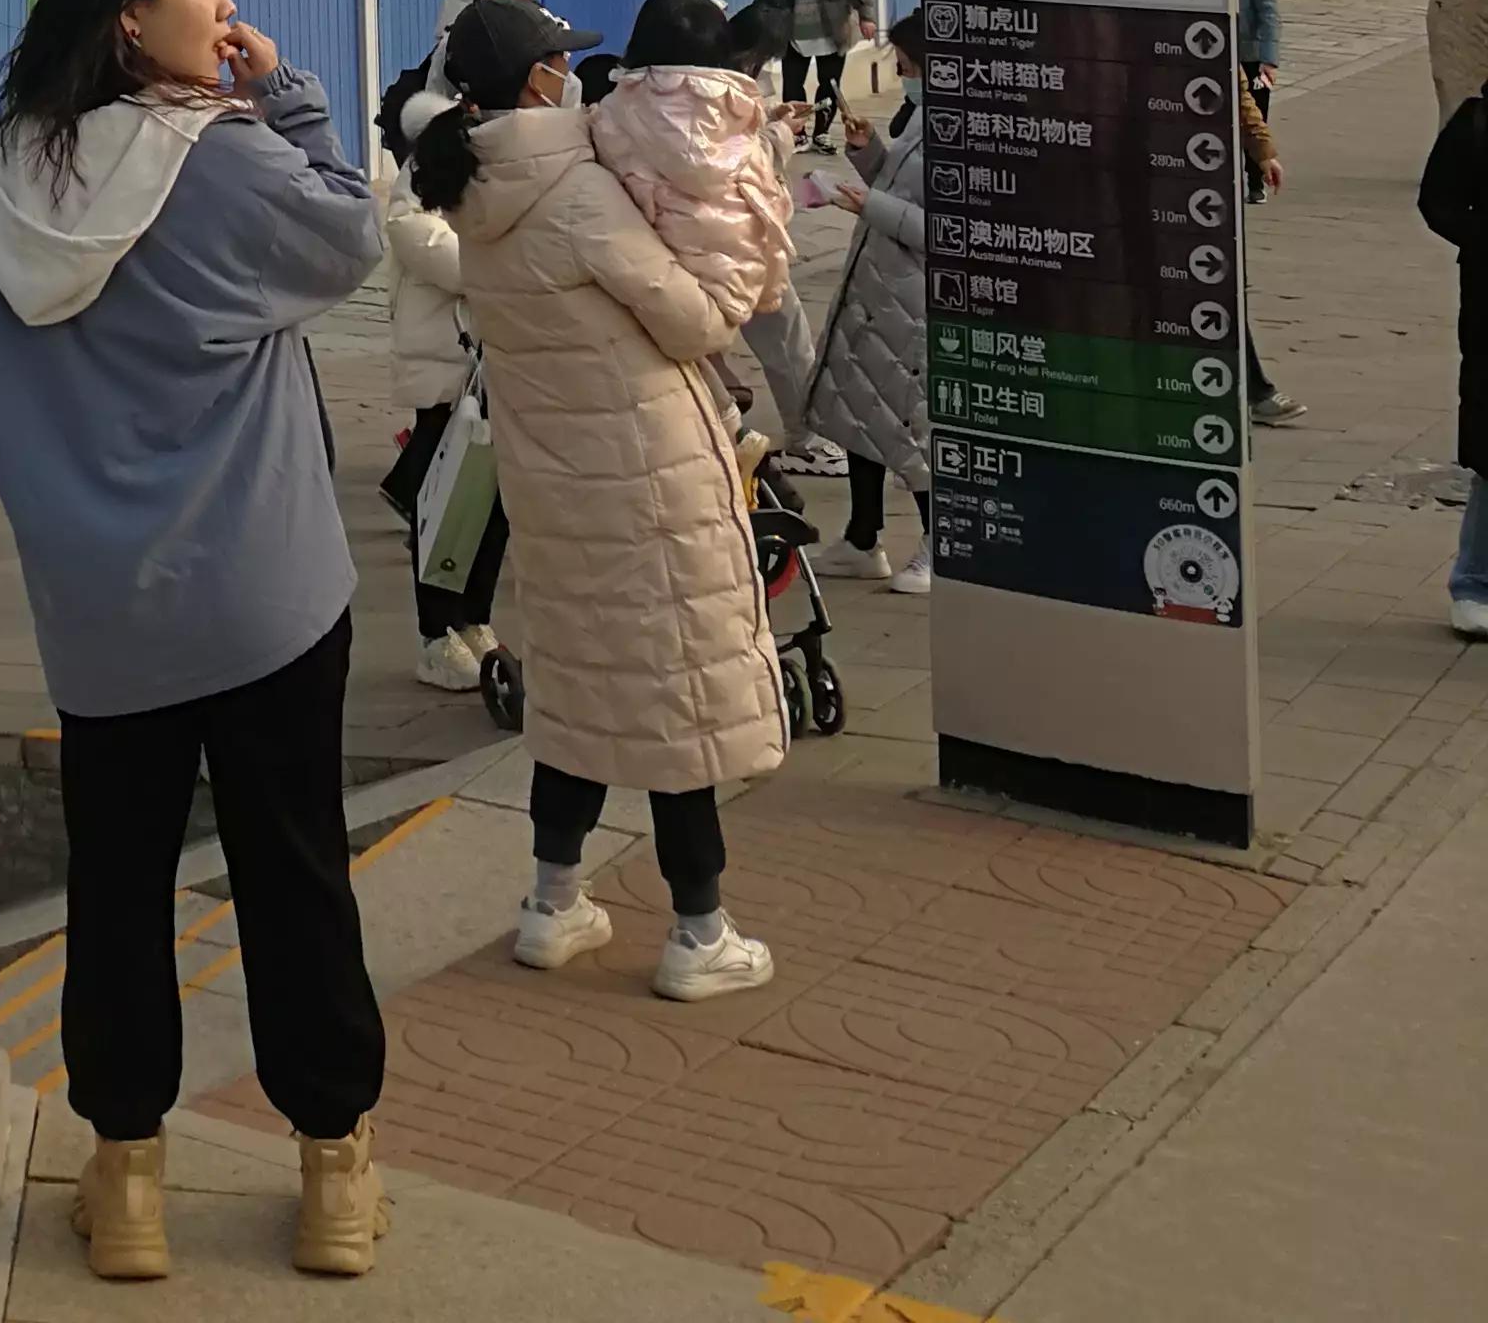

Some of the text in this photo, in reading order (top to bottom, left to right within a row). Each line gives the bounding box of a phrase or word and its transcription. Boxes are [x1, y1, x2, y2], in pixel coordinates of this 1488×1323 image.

[965, 4, 1038, 34] 狮虎山
[965, 34, 1036, 50] Lion and Tiger
[1155, 41, 1182, 55] 80m
[966, 58, 1065, 91] 大熊猫馆
[966, 87, 1028, 103] Giant Panda
[967, 111, 1093, 147] 猫科动物馆
[999, 142, 1038, 157] House
[968, 166, 1016, 195] 熊山
[1152, 209, 1187, 224] 310m
[969, 219, 1096, 259] 澳洲动物区
[968, 248, 1062, 270] Australian Animals
[970, 274, 1019, 305] 貘馆
[1153, 321, 1190, 337] 300m
[1041, 368, 1099, 386] Restaurant
[1156, 377, 1191, 393] 110m
[971, 382, 1045, 419] 卫生间
[973, 412, 999, 426] Toilet
[1156, 434, 1191, 449] 100m
[973, 445, 1022, 477] 正门
[973, 473, 999, 487] Gate
[1159, 498, 1195, 514] 660m
